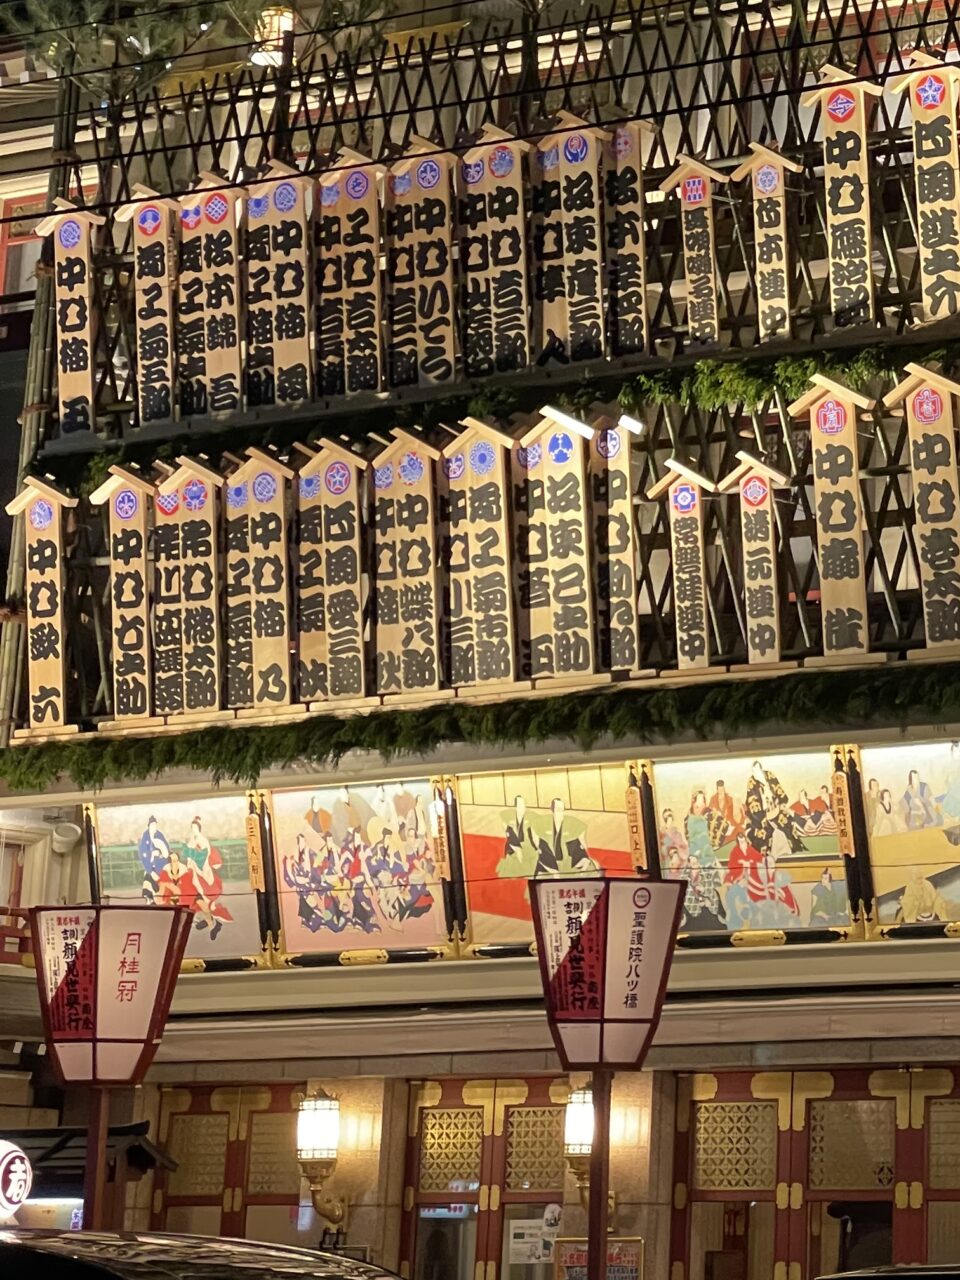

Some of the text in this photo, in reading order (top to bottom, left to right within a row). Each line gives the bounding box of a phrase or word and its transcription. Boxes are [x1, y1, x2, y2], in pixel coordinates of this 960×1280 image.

[630, 824, 641, 851] 口上
[115, 932, 142, 1003] 月桂冠
